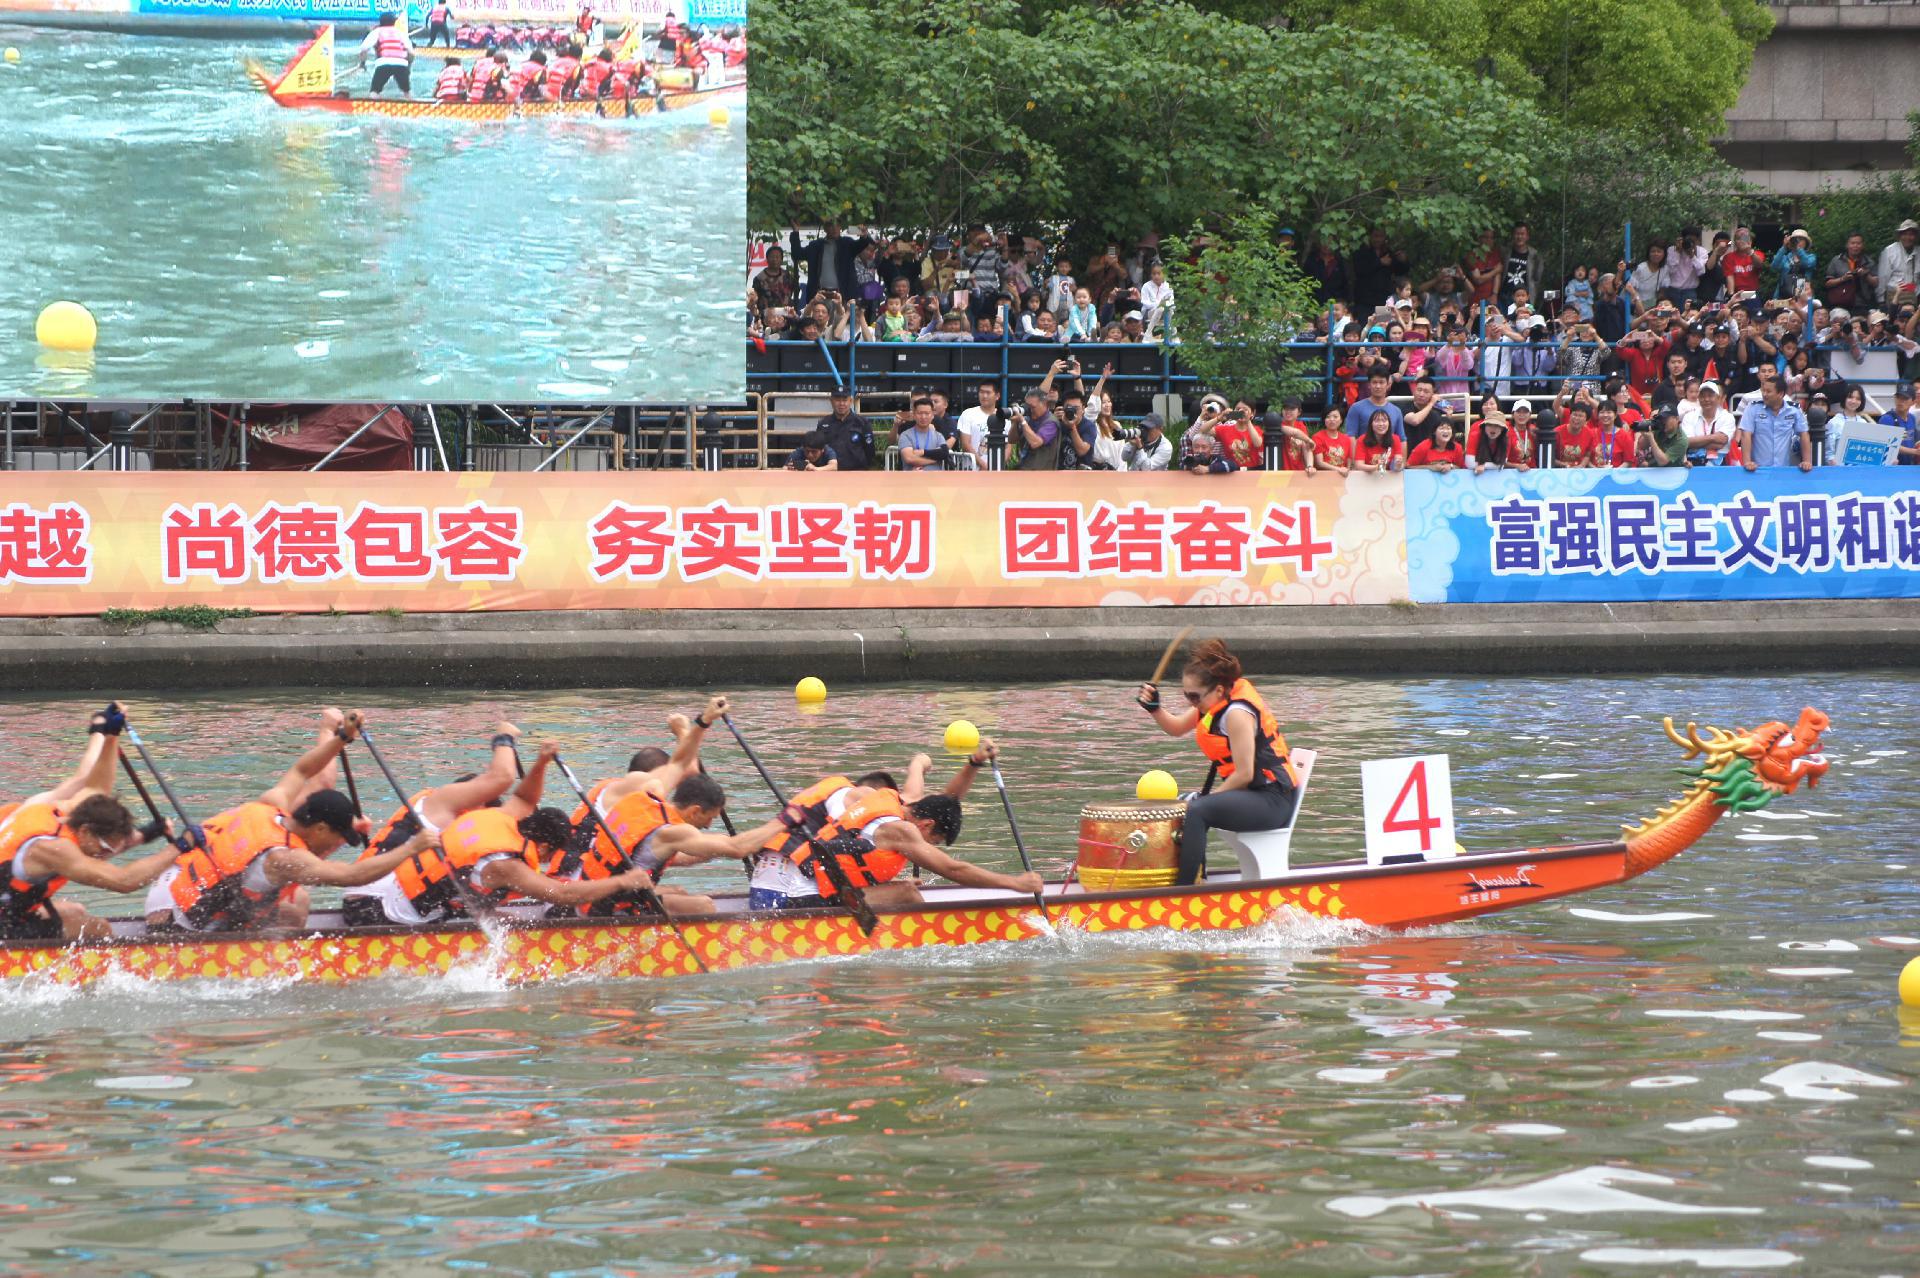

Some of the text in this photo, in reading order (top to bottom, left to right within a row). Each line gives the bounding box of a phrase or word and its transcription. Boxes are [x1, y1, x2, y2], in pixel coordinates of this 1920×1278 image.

[0, 504, 1334, 579] 越 尚德包容 务实坚韧 团结奋斗
[1383, 760, 1442, 851] 4
